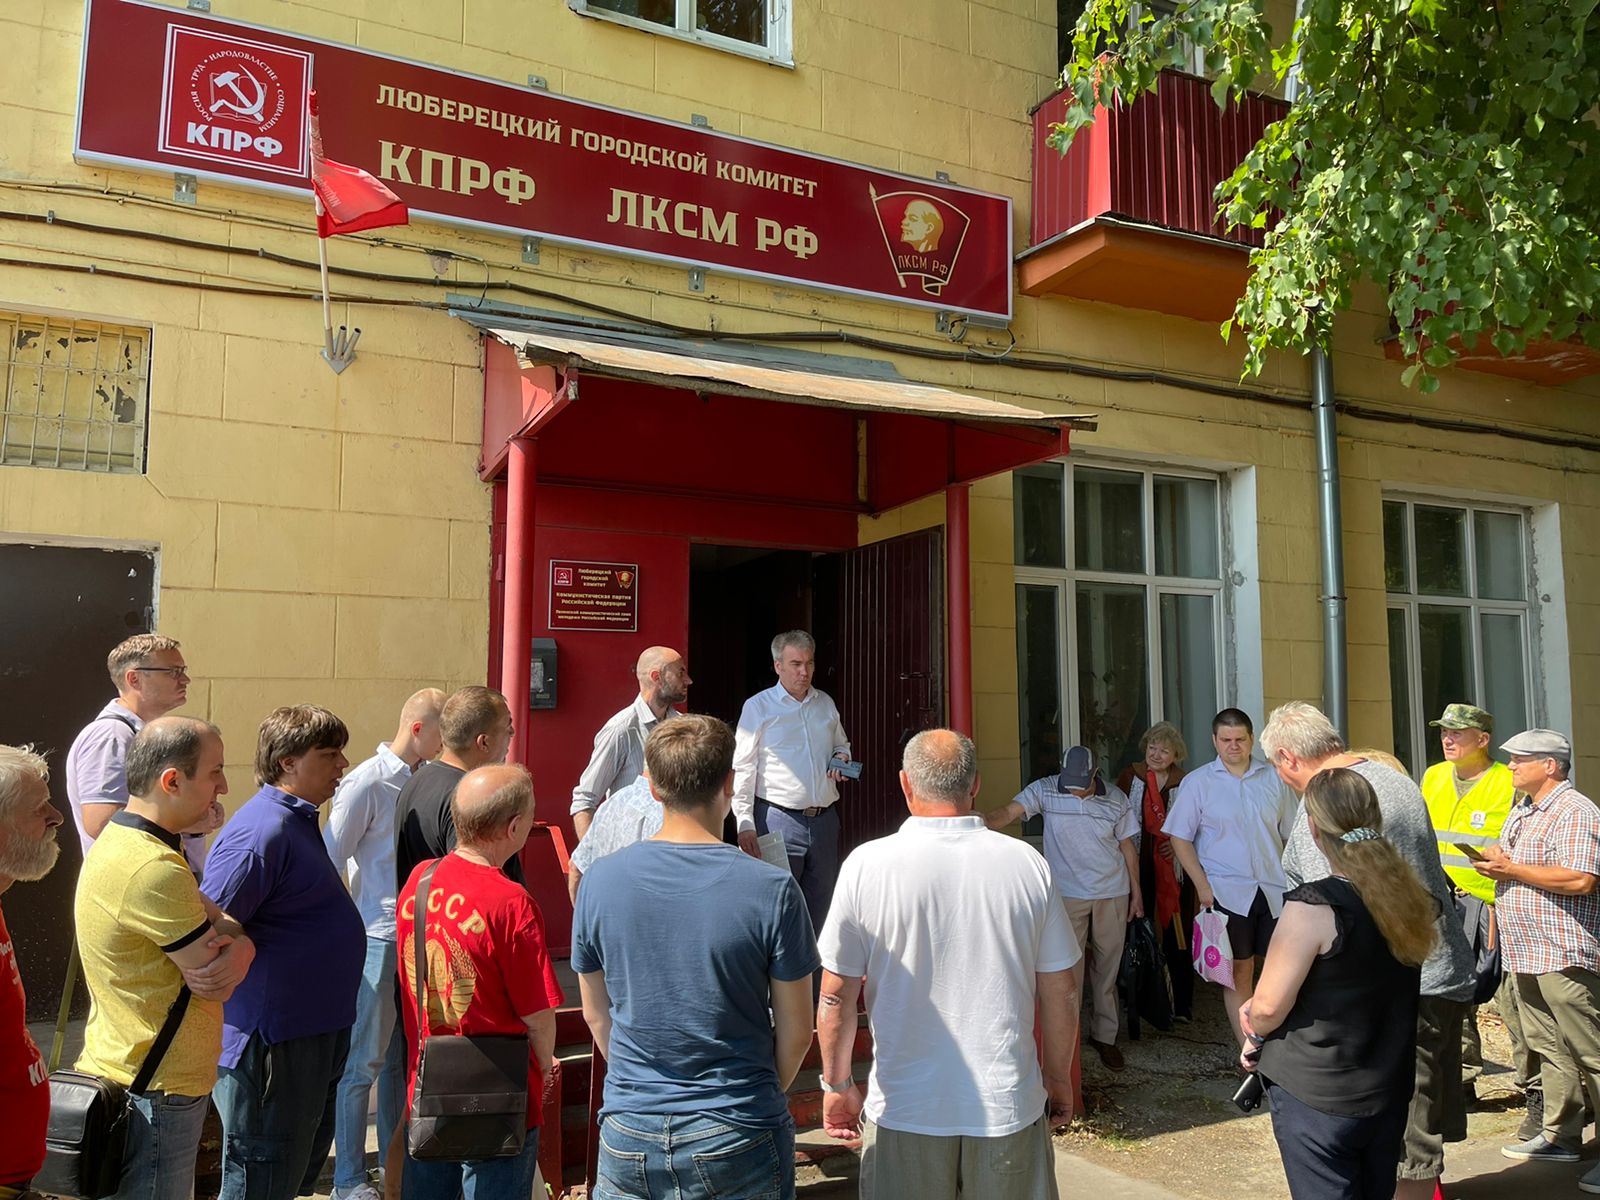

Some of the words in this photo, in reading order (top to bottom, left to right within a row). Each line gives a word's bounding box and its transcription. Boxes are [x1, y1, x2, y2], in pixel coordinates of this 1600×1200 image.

[191, 64, 206, 81] ТРУД
[209, 50, 278, 81] НАРОДОВЛАСТИЕ
[191, 91, 213, 122] РОССИЯ
[258, 89, 285, 133] СОЦИАЛИЗМ
[187, 121, 283, 158] КПРФ
[376, 84, 562, 144] ЛЮБЕРЕЦКИЙ
[570, 128, 708, 175] ГОРОДСКОЙ
[716, 160, 818, 198] КОМИТЕТ
[377, 139, 536, 205] КПРФ
[607, 187, 739, 246] ЛКСМ
[755, 217, 818, 260] РФ
[898, 254, 927, 270] ЛКСМ
[932, 259, 949, 276] РФ
[401, 888, 486, 936] СССР
